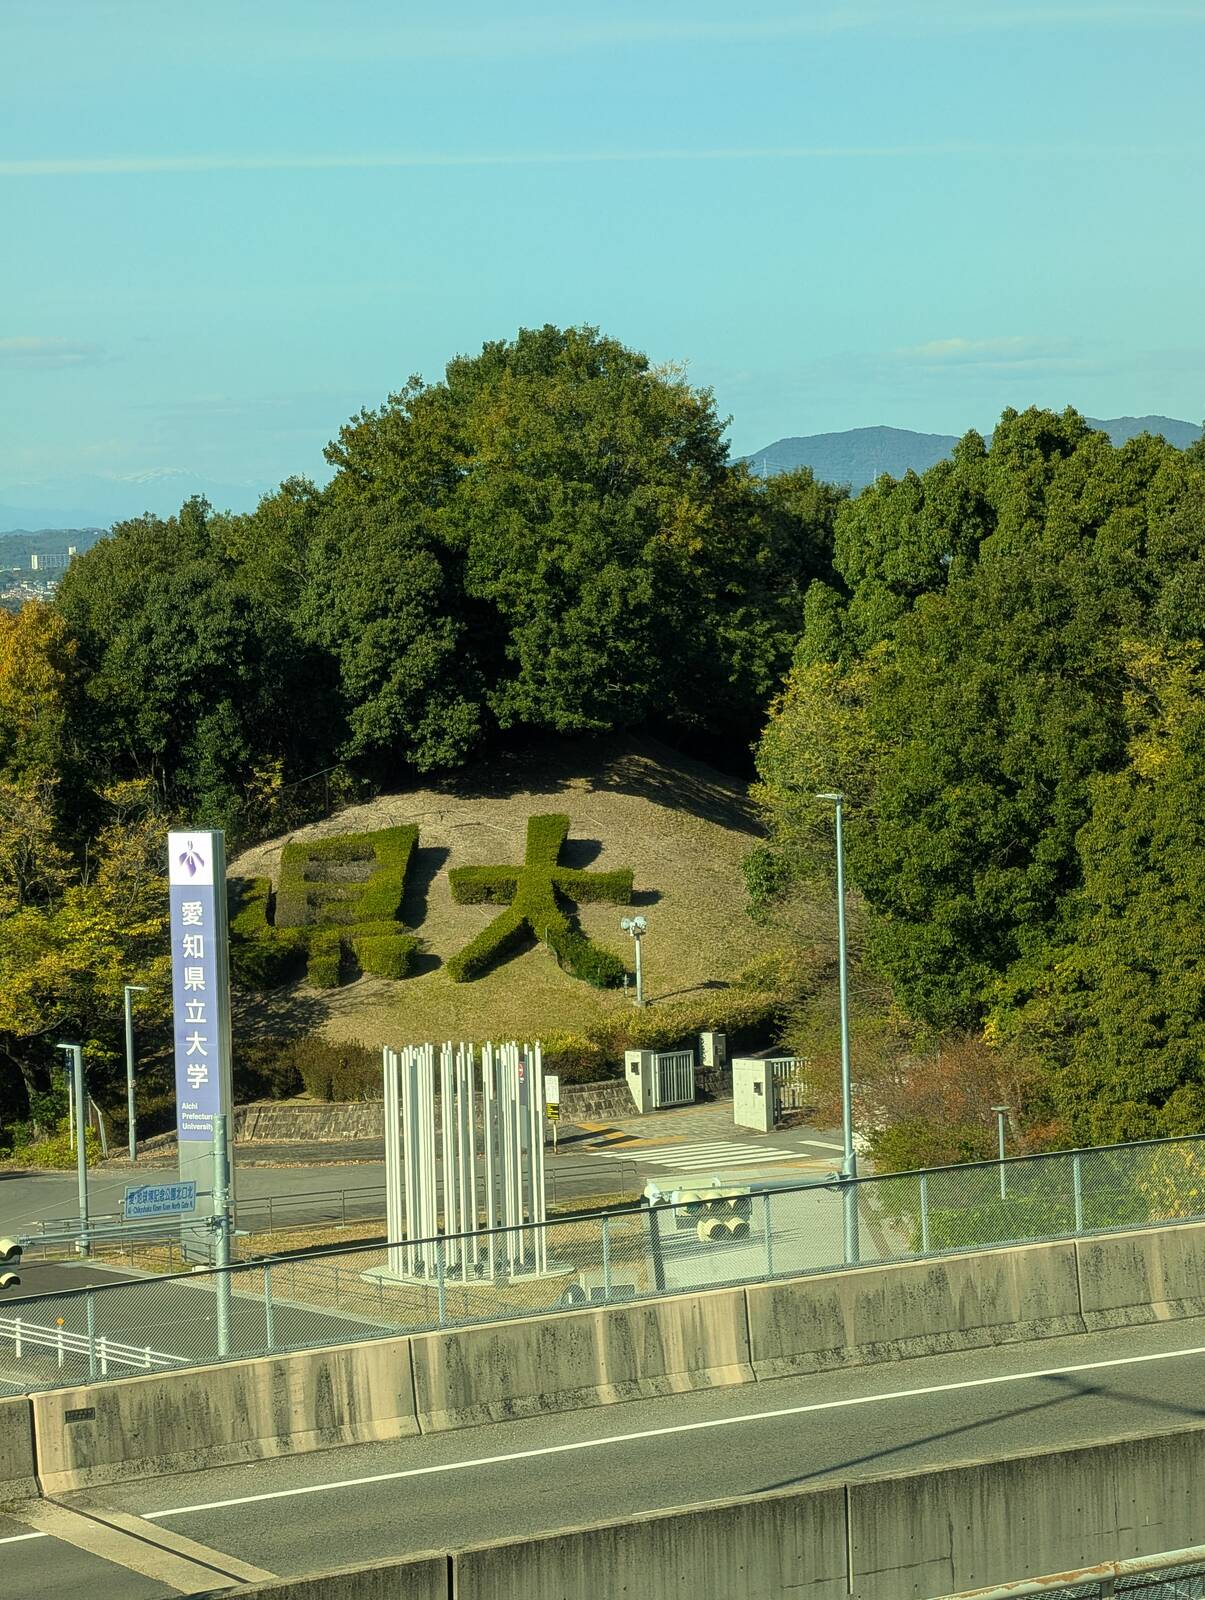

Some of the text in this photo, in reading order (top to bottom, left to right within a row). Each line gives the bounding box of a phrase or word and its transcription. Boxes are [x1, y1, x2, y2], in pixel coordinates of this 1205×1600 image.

[181, 901, 209, 1089] 愛知県立大学
[182, 1102, 198, 1110] Aichi
[182, 1112, 216, 1120] Prefectur
[182, 1122, 214, 1132] University
